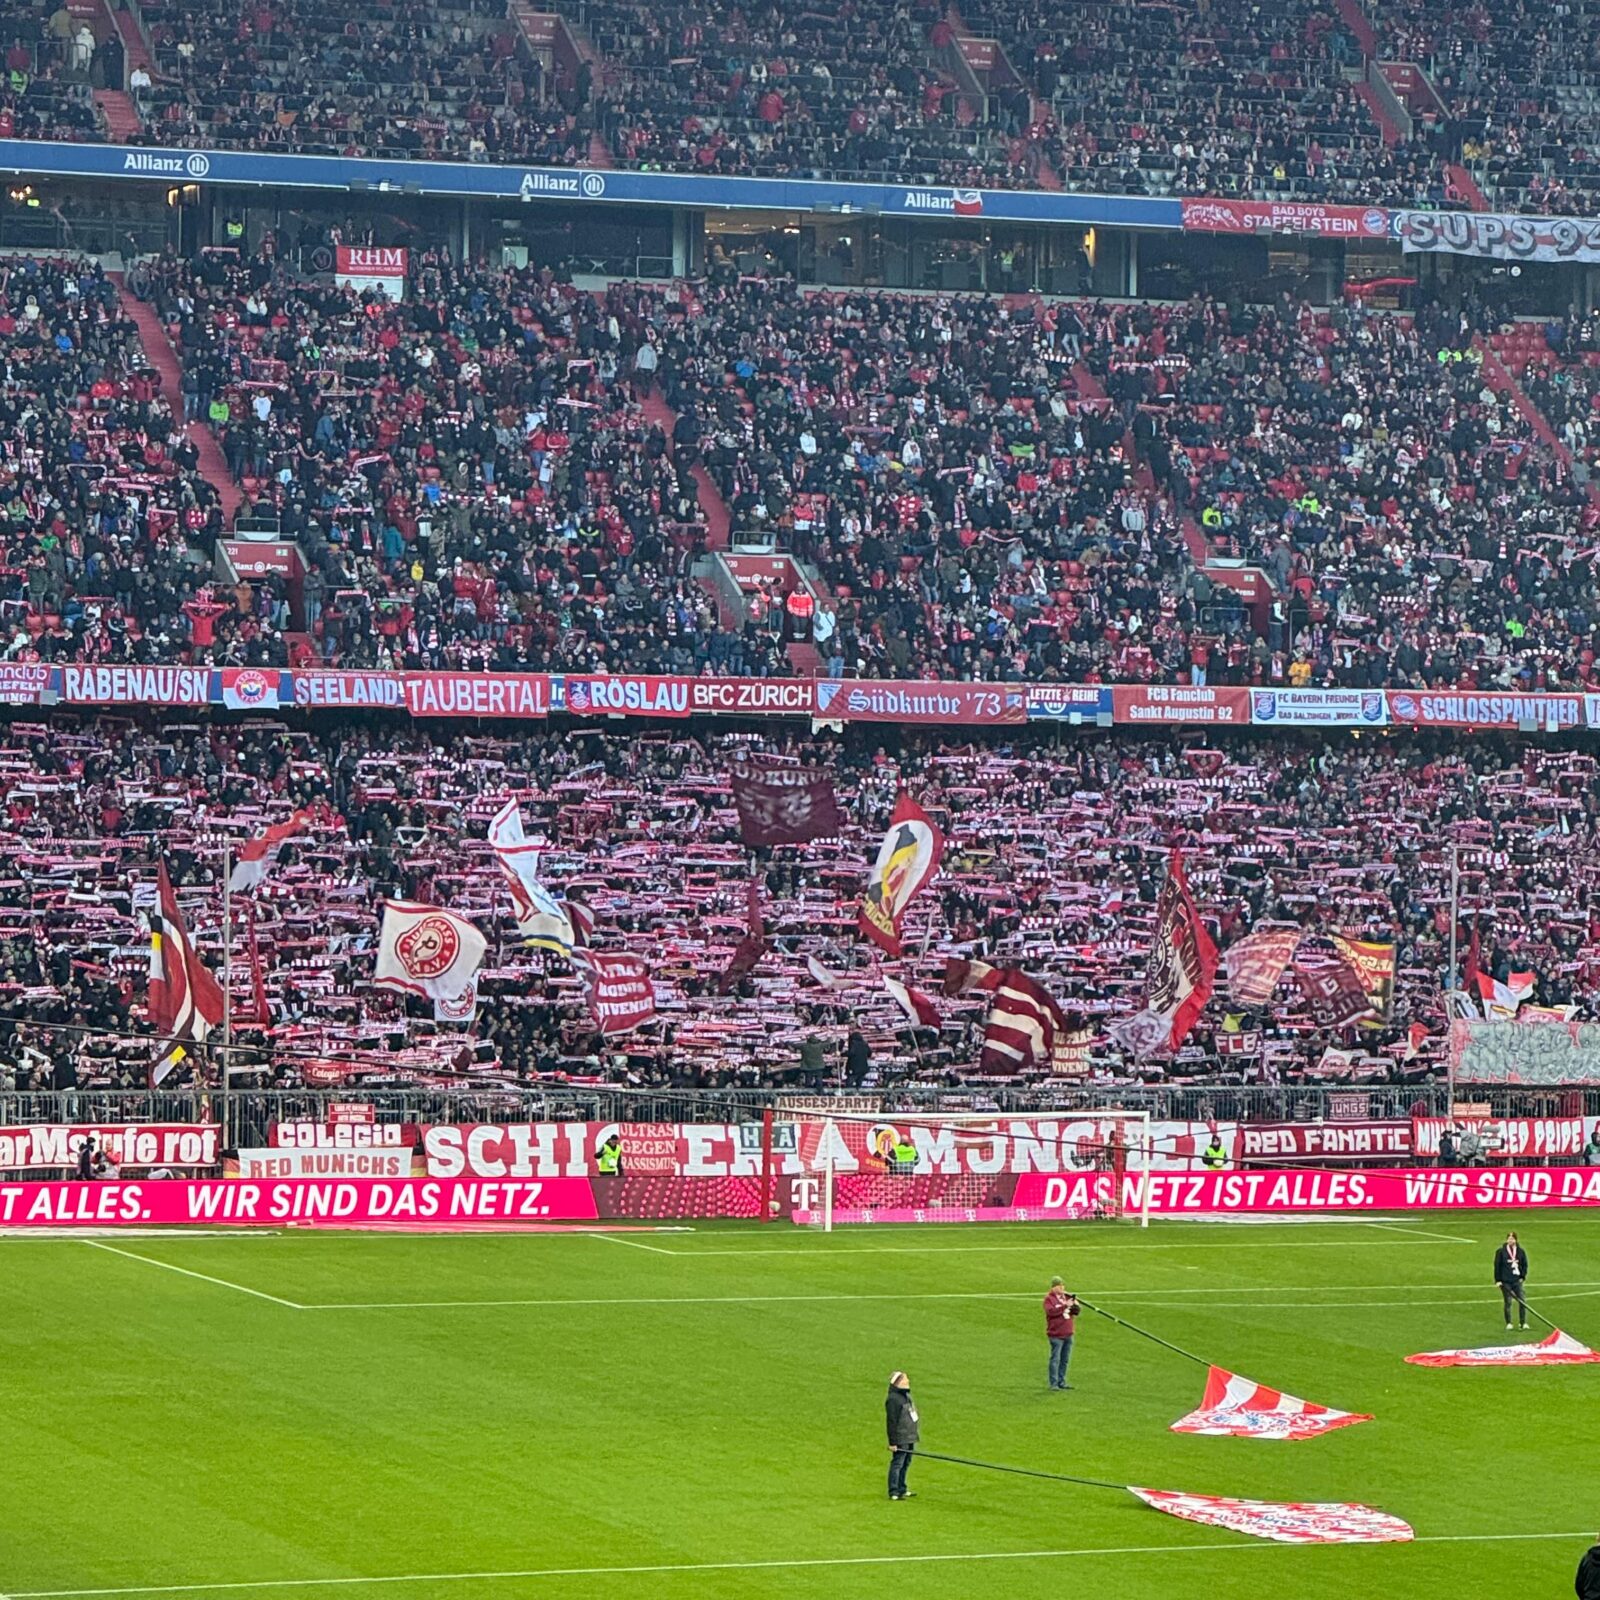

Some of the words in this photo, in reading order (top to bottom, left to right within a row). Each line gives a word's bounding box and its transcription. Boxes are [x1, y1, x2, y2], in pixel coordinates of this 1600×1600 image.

[124, 153, 183, 172] Allianz
[521, 172, 577, 191] Allianz
[1243, 213, 1358, 232] STAFFELSTEIN
[1272, 205, 1293, 216] BAD
[1297, 207, 1325, 217] BOYS
[1408, 213, 1536, 256] SUPS
[348, 248, 403, 266] RHM
[65, 668, 208, 702] RABENAU/SN
[295, 677, 398, 704] SEELAND
[407, 679, 546, 713] TAUBERTAL
[590, 679, 688, 712] RÖSLAU
[693, 684, 734, 705] BFC
[738, 684, 812, 706] ZÜRICH
[1030, 688, 1062, 701] LETZTE
[1072, 689, 1099, 702] REIHE
[1147, 688, 1168, 702] FCB
[1170, 688, 1215, 702] Fanclub
[1278, 693, 1289, 703] FC
[1291, 693, 1323, 704] BAYERN
[1325, 694, 1360, 704] FREUNDE
[848, 688, 960, 715] Südkurve
[1129, 705, 1162, 719] Sankt
[1165, 706, 1215, 720] Augustin
[1421, 696, 1579, 724] SCHLOSSPANTHER
[1215, 1033, 1257, 1053] FCB
[779, 1097, 879, 1109] AUSGESPERRTE
[164, 1129, 216, 1164] rot
[1534, 1119, 1582, 1155] PRIDE
[250, 1158, 292, 1178] RED
[187, 1184, 261, 1218] WIR
[269, 1183, 358, 1217] SIND
[367, 1183, 441, 1216] DAS
[450, 1182, 551, 1216] NETZ.
[791, 1179, 819, 1211] T
[1044, 1177, 1112, 1208] DAS
[1122, 1176, 1205, 1208] NETZ
[1213, 1175, 1265, 1207] IST
[1267, 1174, 1374, 1206] ALLES.
[1405, 1172, 1469, 1204] WIR
[1475, 1171, 1552, 1203] SIND
[26, 1185, 152, 1220] ALLES.
